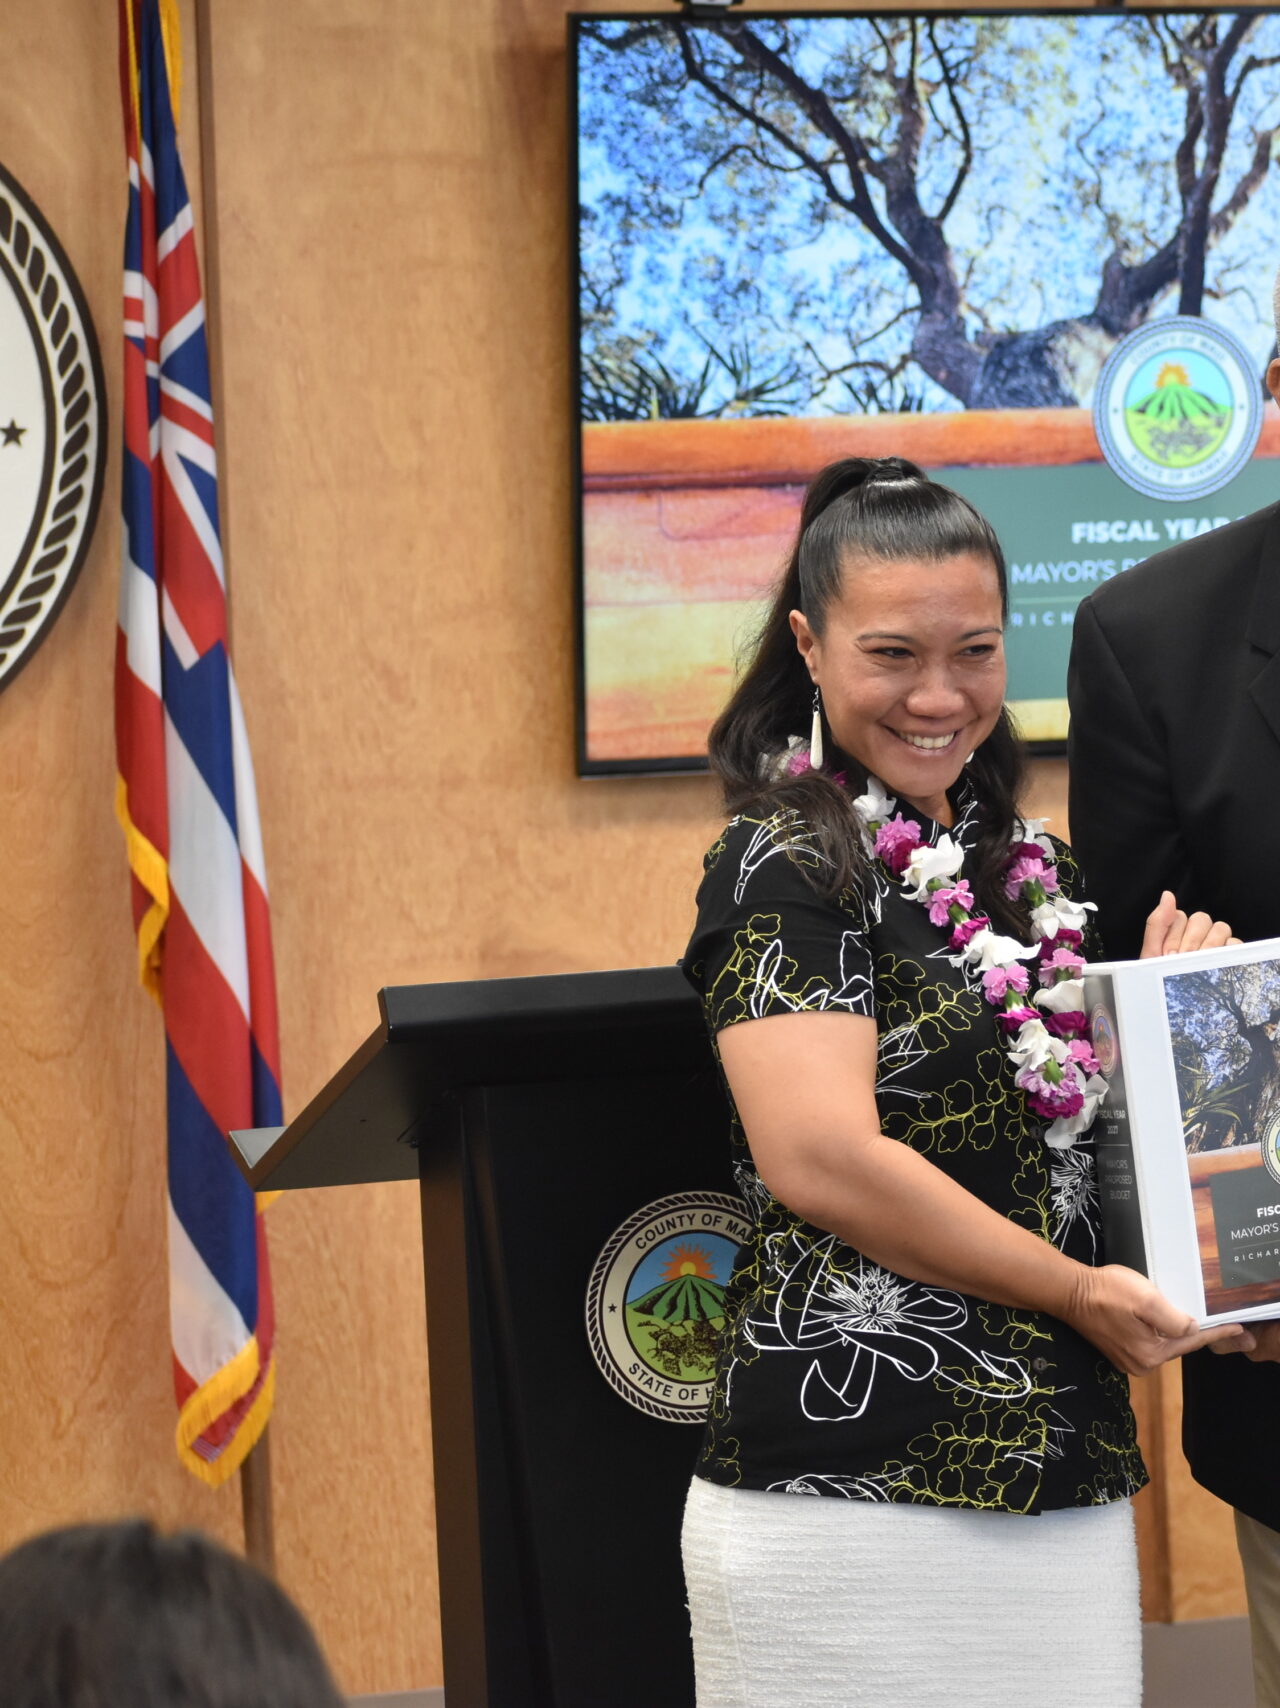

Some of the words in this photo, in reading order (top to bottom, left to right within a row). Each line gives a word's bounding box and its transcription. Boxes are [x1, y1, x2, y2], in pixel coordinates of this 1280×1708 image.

[1071, 519, 1160, 544] FISCAL
[1011, 558, 1117, 584] MAYOR'S
[635, 1213, 696, 1250] COUNTY
[701, 1213, 722, 1227] OF
[725, 1221, 749, 1240] MA
[1231, 1222, 1279, 1241] MAYOR'S
[628, 1362, 673, 1398] STATE
[678, 1387, 699, 1400] OF
